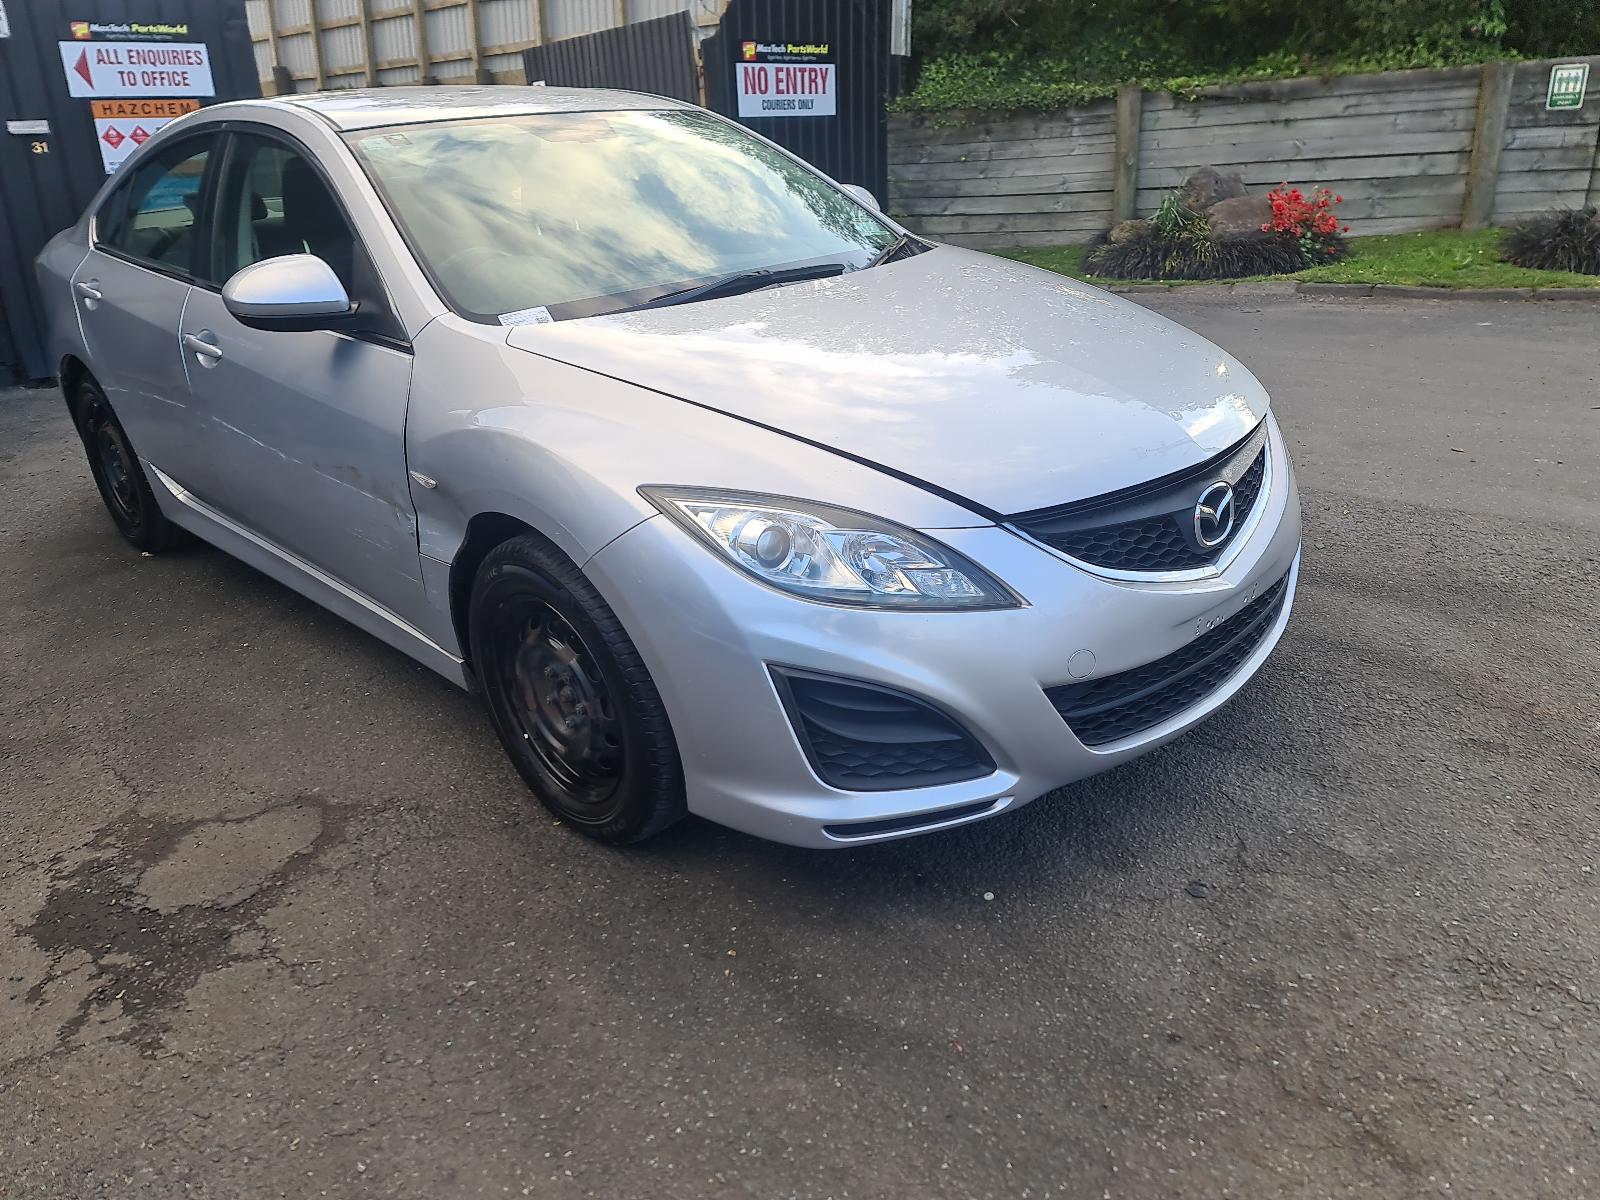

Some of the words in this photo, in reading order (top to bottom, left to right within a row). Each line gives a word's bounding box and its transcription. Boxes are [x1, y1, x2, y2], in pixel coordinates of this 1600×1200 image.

[131, 24, 187, 34] PartsWorld
[787, 44, 828, 54] PartsWorld
[96, 48, 122, 65] ALL
[128, 49, 203, 66] ENQUIRIES
[118, 71, 137, 87] TO
[141, 71, 190, 87] OFFICE
[744, 66, 769, 95] NO
[775, 67, 829, 95] ENTRY
[101, 103, 192, 115] HAZCHEM
[762, 99, 796, 111] COURIERS
[798, 99, 814, 110] ONLY
[31, 141, 49, 154] 31
